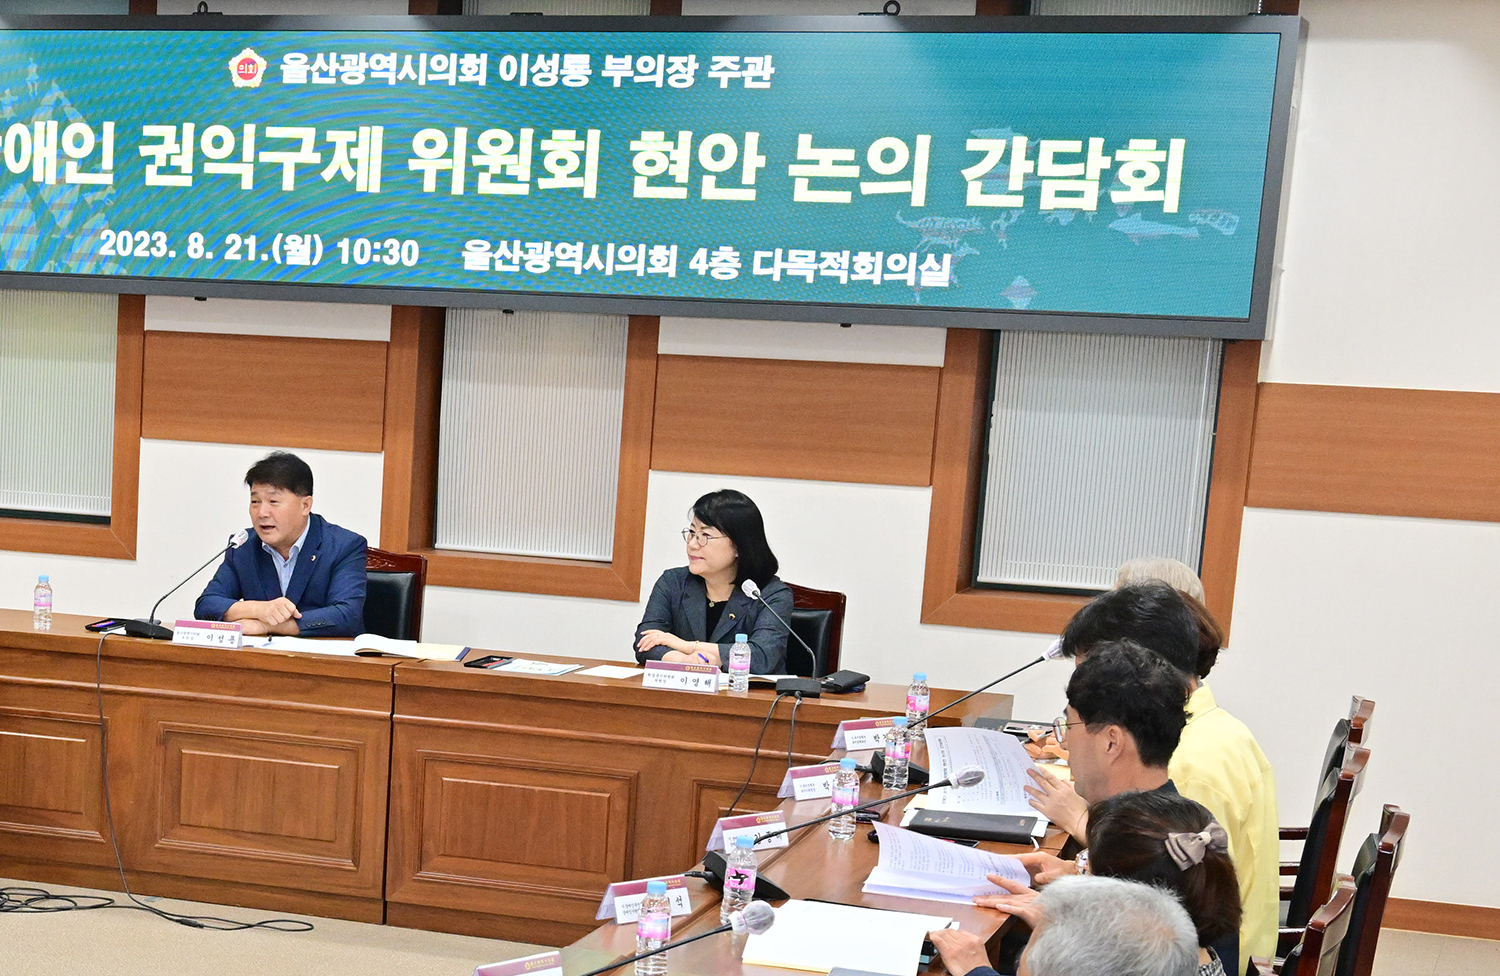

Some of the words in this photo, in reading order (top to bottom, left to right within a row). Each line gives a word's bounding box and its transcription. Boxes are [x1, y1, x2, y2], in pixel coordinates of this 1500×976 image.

[237, 63, 258, 74] 의회
[280, 52, 488, 87] 울산광역시의회
[499, 53, 592, 87] 이성룡
[601, 54, 699, 89] 부의장
[708, 55, 775, 89] 주관
[138, 122, 384, 193] 권익구제
[407, 127, 601, 199] 위원회
[629, 130, 766, 201] 현안
[788, 133, 932, 207] 논의
[960, 135, 1186, 213] 간담회
[98, 229, 176, 259] 2023.
[187, 232, 213, 260] 8.
[224, 233, 323, 266] 21.(월)
[337, 238, 419, 267] 10:30
[461, 239, 678, 278] 울산광역시의회
[689, 246, 742, 280] 4층
[752, 248, 952, 287] 다목적회의실
